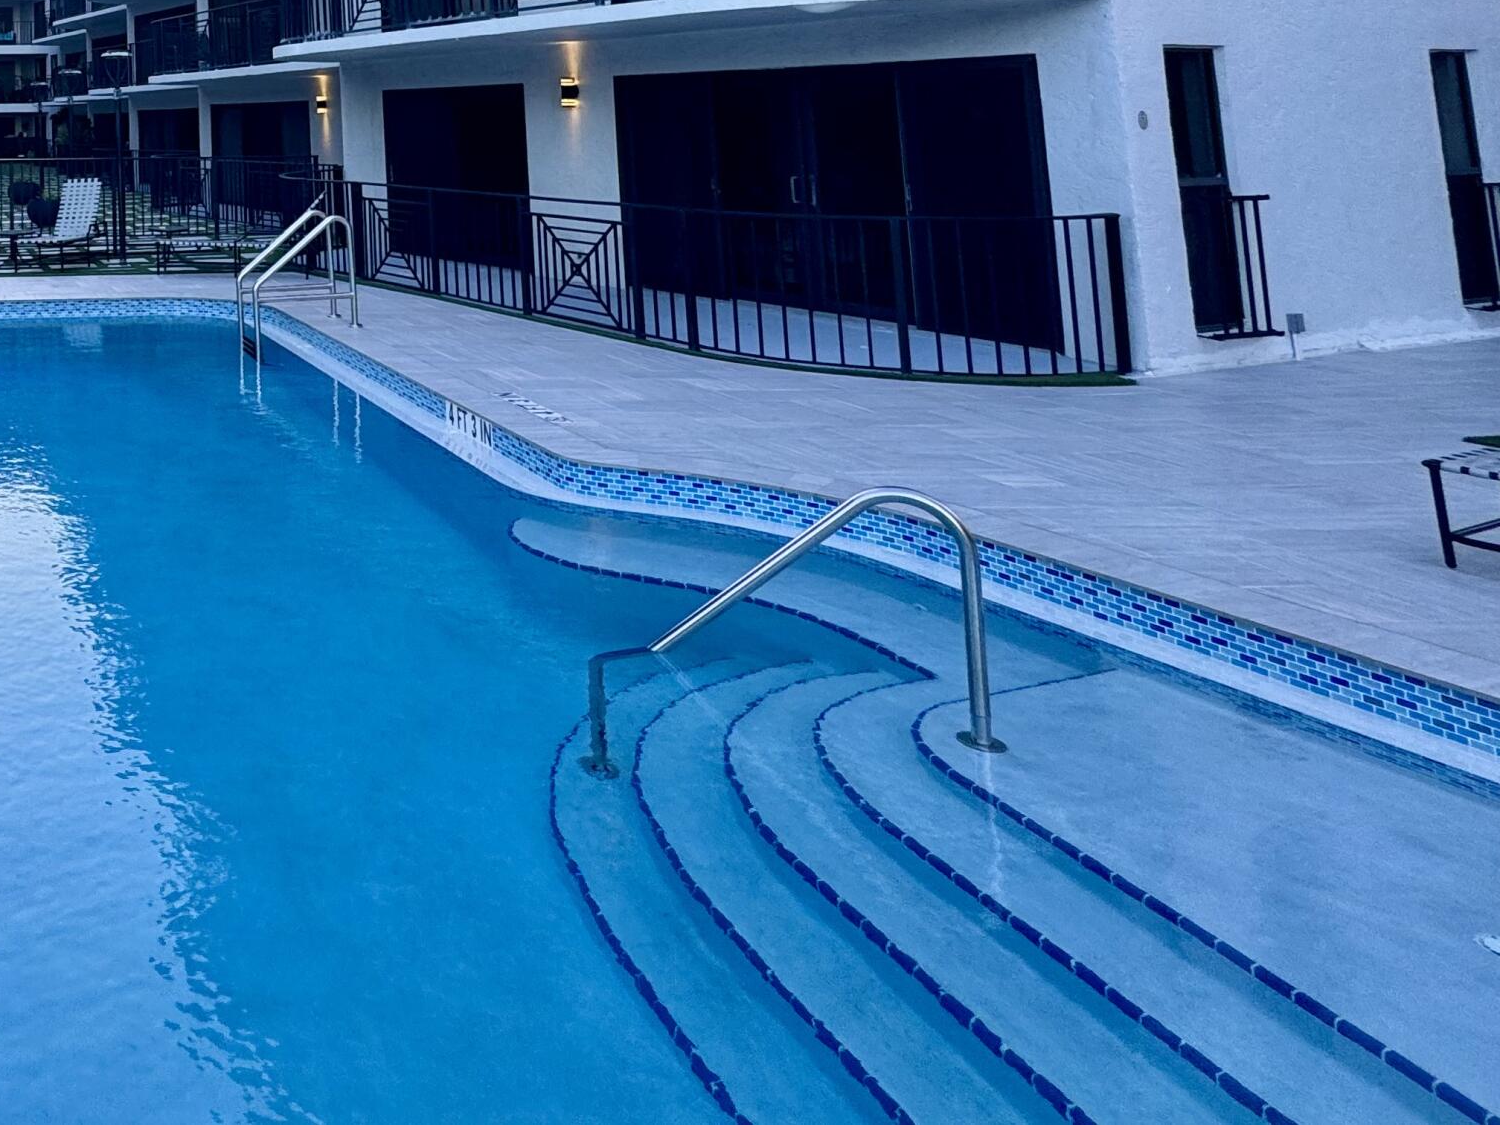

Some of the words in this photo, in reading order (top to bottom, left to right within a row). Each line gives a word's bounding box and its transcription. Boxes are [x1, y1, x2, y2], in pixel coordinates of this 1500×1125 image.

[449, 402, 454, 426] 4
[457, 406, 468, 433] FT
[471, 414, 477, 438] 3
[480, 418, 492, 448] IN
